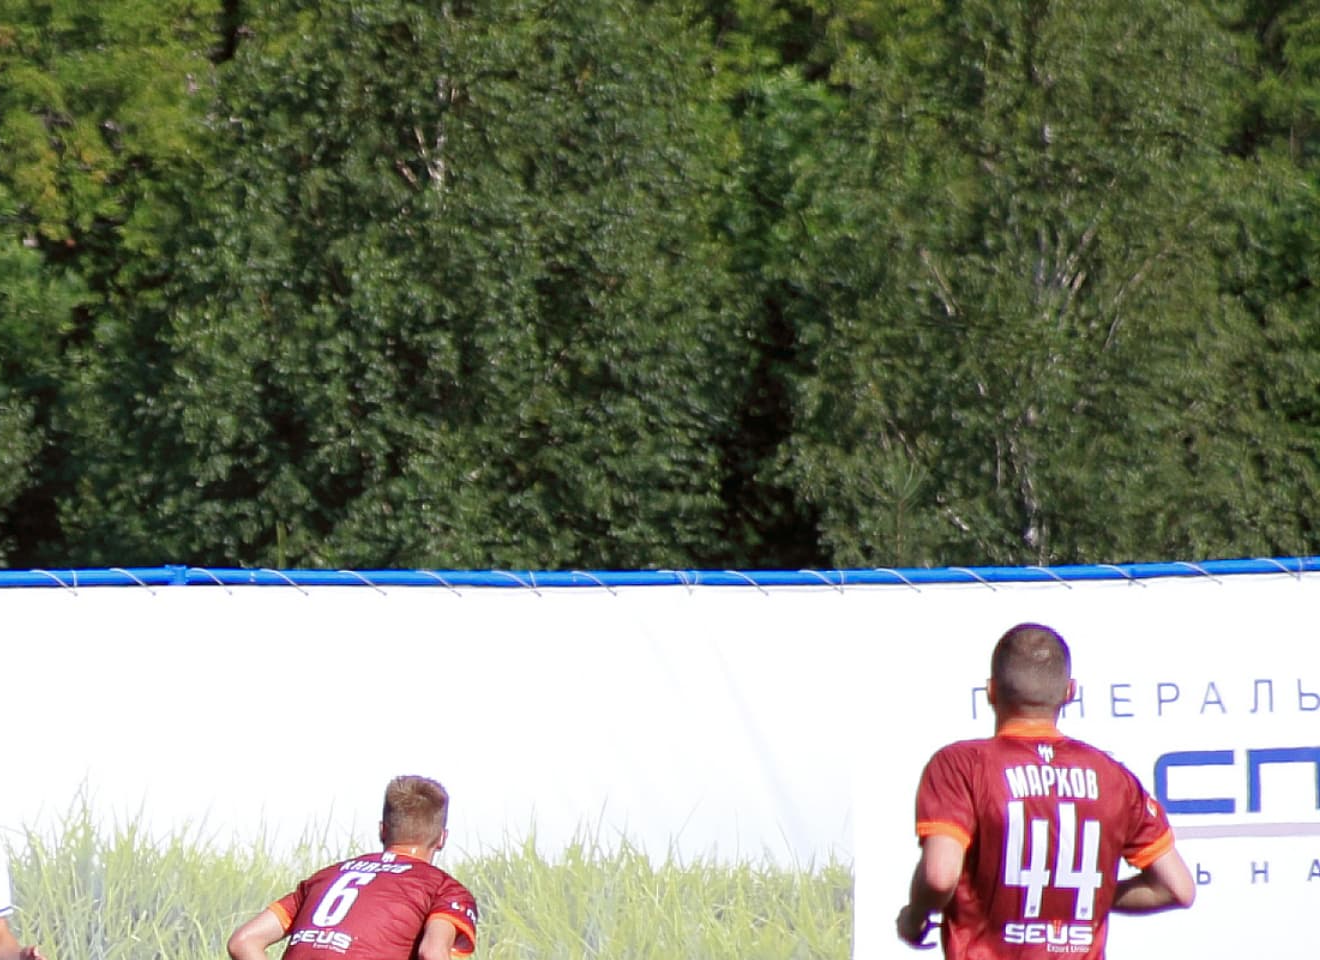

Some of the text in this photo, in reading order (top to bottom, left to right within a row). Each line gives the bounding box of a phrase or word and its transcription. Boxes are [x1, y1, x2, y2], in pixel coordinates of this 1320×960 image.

[972, 678, 1320, 720] ГНЕРАЛЬ
[1004, 765, 1099, 800] МАРКОВ
[1004, 801, 1102, 920] 44
[312, 871, 376, 927] 6
[1004, 922, 1093, 946] SEUS
